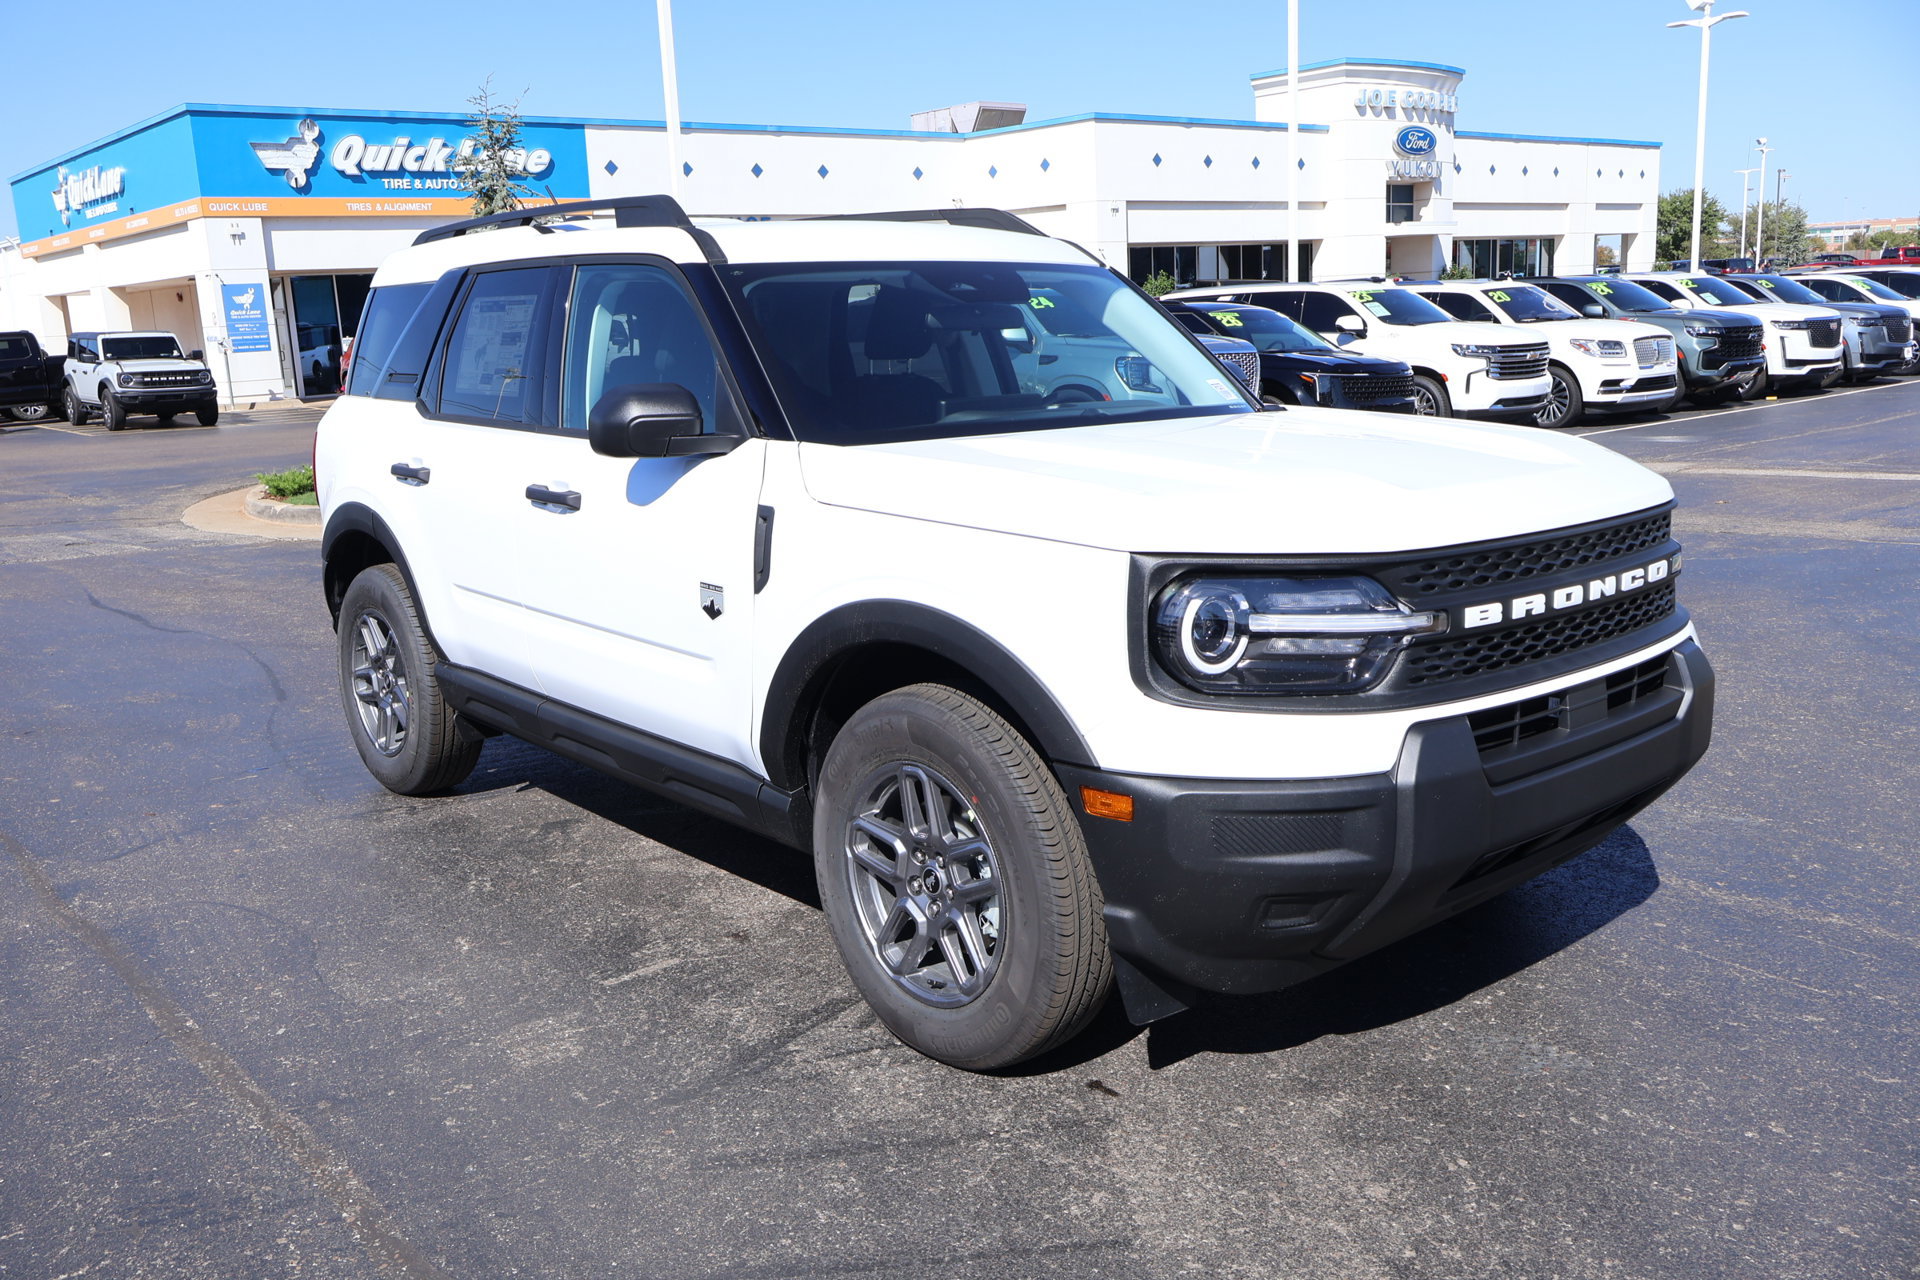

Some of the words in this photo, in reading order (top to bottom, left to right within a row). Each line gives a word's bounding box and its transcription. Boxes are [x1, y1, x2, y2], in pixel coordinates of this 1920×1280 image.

[1358, 89, 1397, 107] JOE
[1404, 91, 1459, 112] COOPER
[1405, 131, 1430, 149] Ford
[332, 134, 454, 175] Quick
[1391, 160, 1443, 177] YUKON
[382, 178, 412, 190] TIRE
[414, 178, 423, 190] &
[426, 179, 458, 191] AUTO
[209, 202, 240, 211] QUICK
[242, 203, 268, 211] LUBE
[346, 202, 372, 211] TIRES
[375, 202, 382, 211] &
[384, 202, 433, 211] ALIGNMENT
[1488, 290, 1511, 302] 20
[1464, 559, 1668, 629] BRONCO
